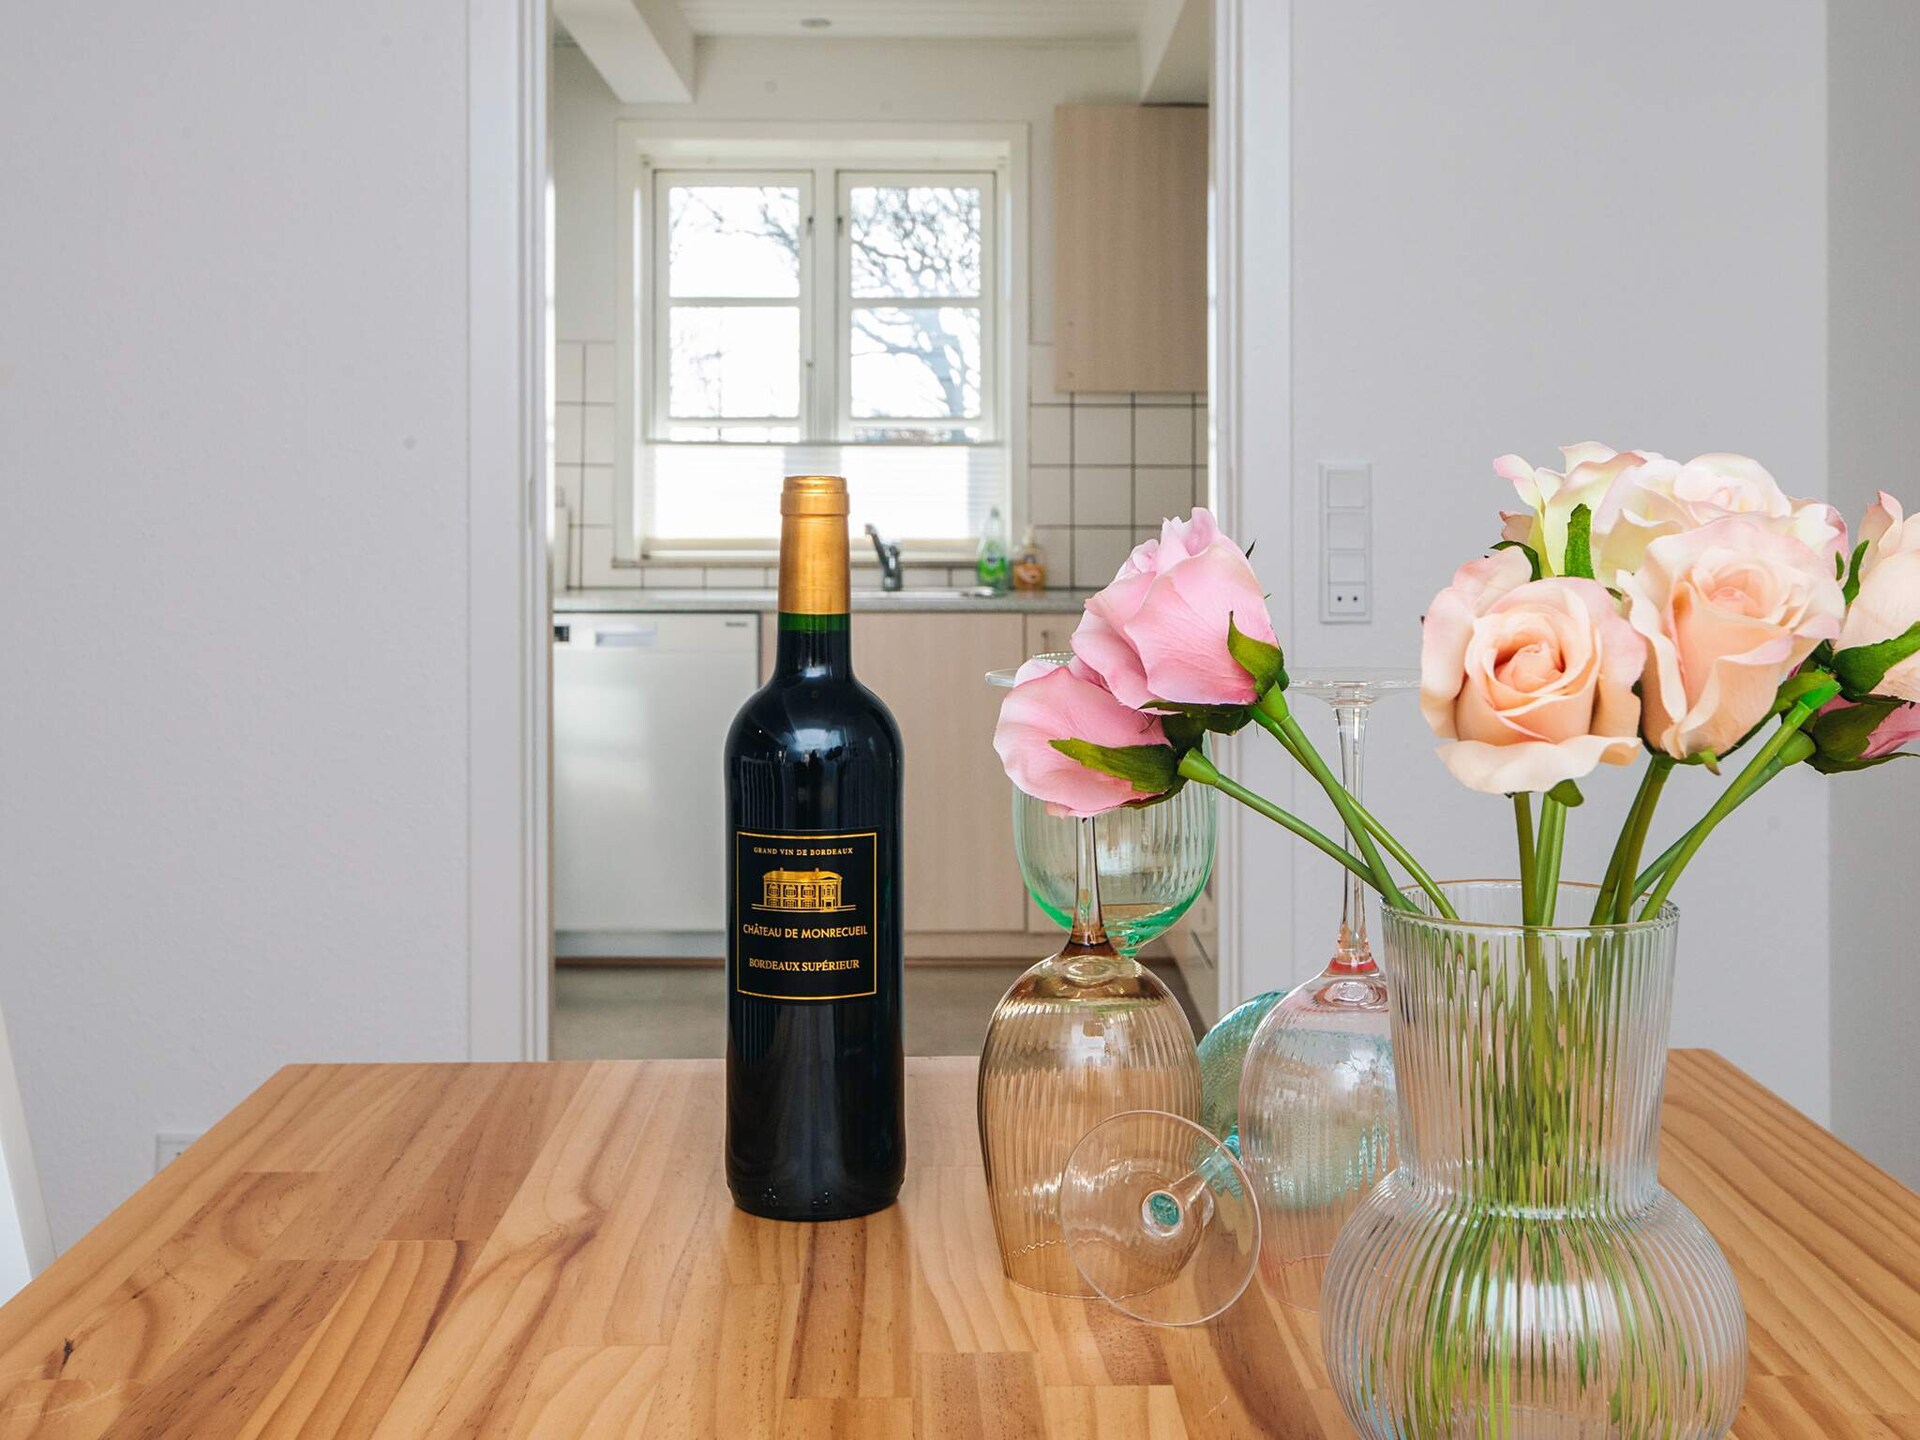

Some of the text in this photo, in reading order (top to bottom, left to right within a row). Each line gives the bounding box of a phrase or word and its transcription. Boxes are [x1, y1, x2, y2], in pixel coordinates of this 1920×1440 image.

[753, 847, 778, 855] GRAND
[810, 847, 853, 856] BORDEAUX
[743, 923, 868, 939] CHÂTEAU DE MONRECUEIL
[749, 957, 860, 972] BORDEAUX SUPÉRIEUR
